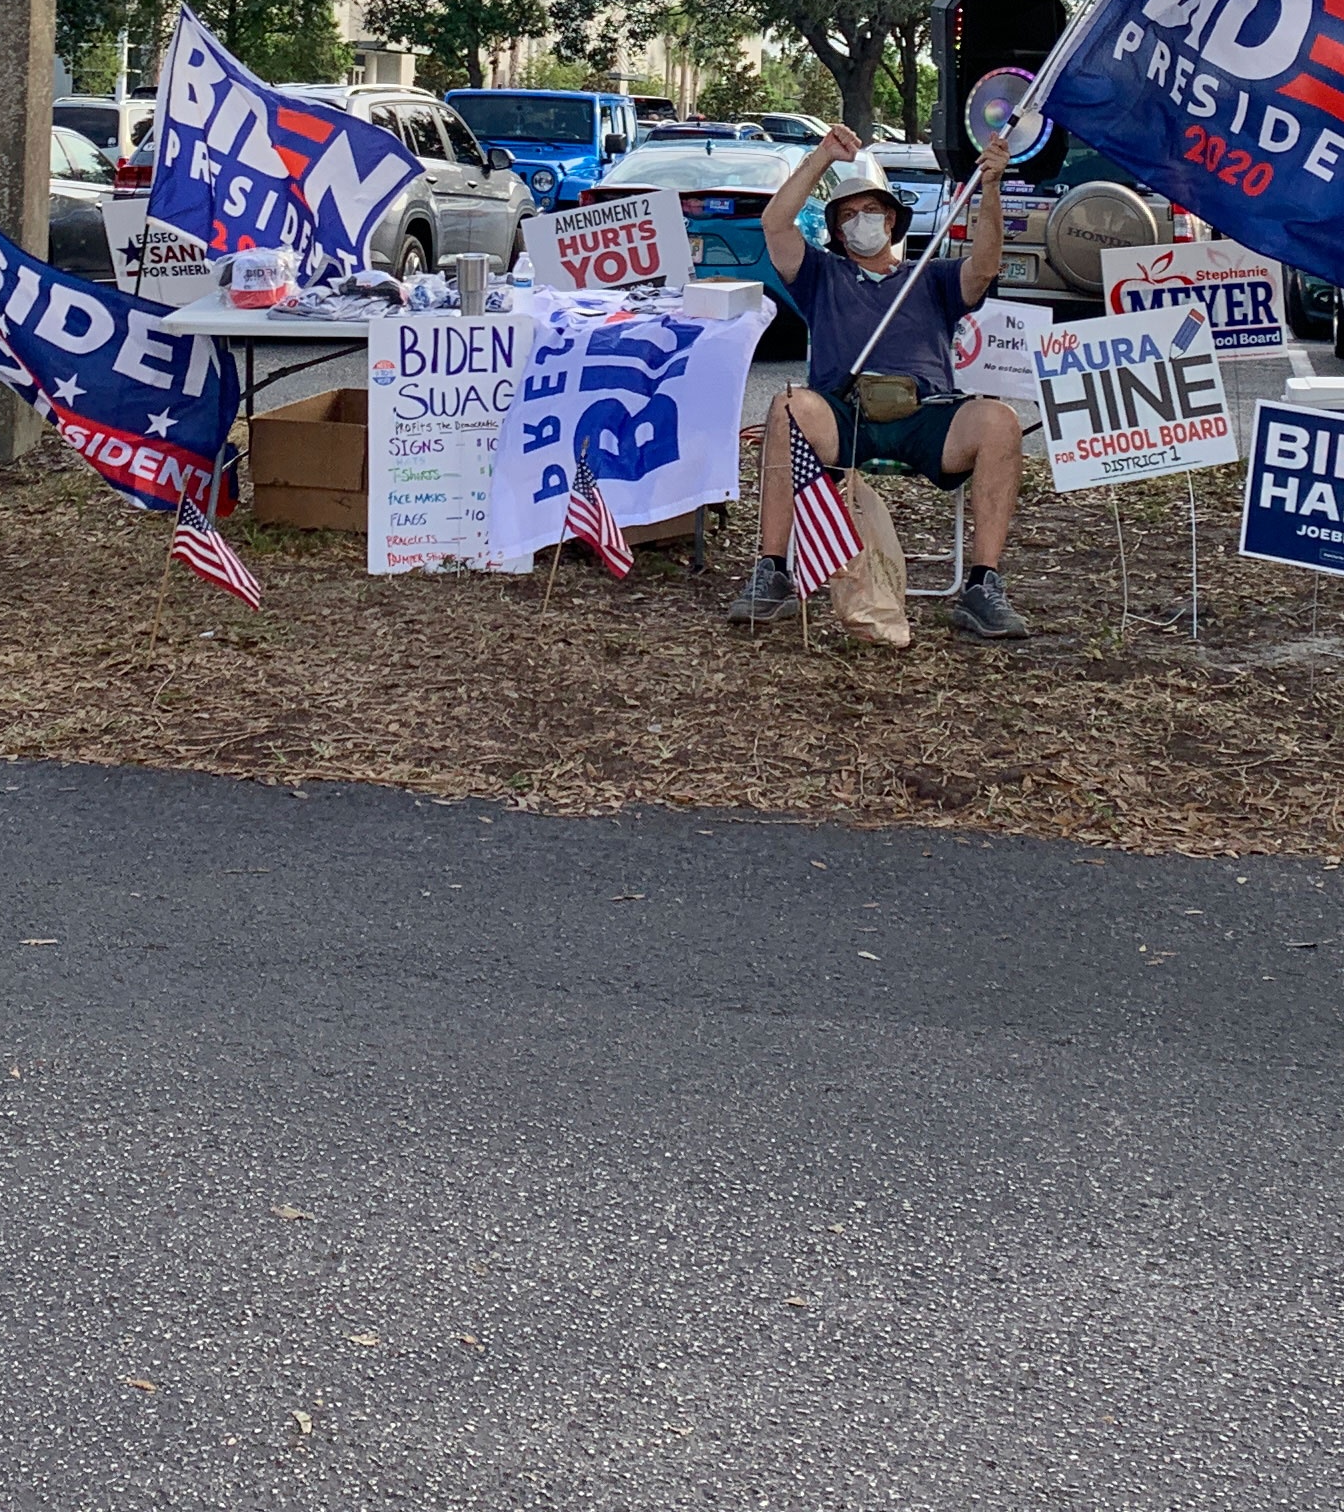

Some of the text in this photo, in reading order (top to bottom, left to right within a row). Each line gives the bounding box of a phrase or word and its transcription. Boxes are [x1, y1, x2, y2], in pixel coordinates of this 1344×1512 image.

[1183, 125, 1274, 197] 2020
[555, 199, 652, 235] AMENDMENT 2
[558, 219, 657, 258] HURTS
[142, 266, 169, 278] FOR
[560, 243, 660, 290] YOU
[1196, 266, 1269, 283] Stephanie
[1006, 315, 1025, 330] No
[1239, 331, 1281, 346] Board
[400, 325, 515, 377] BIDEN
[1034, 334, 1163, 379] LAURA
[1040, 330, 1081, 358] Vote
[983, 363, 996, 371] No
[393, 379, 515, 420] SWAG
[1040, 354, 1224, 441] HINE
[389, 437, 445, 456] SIGNS
[1055, 416, 1229, 465] FOR SCHOOL BOARD
[1102, 446, 1181, 474] DISTRICT 1
